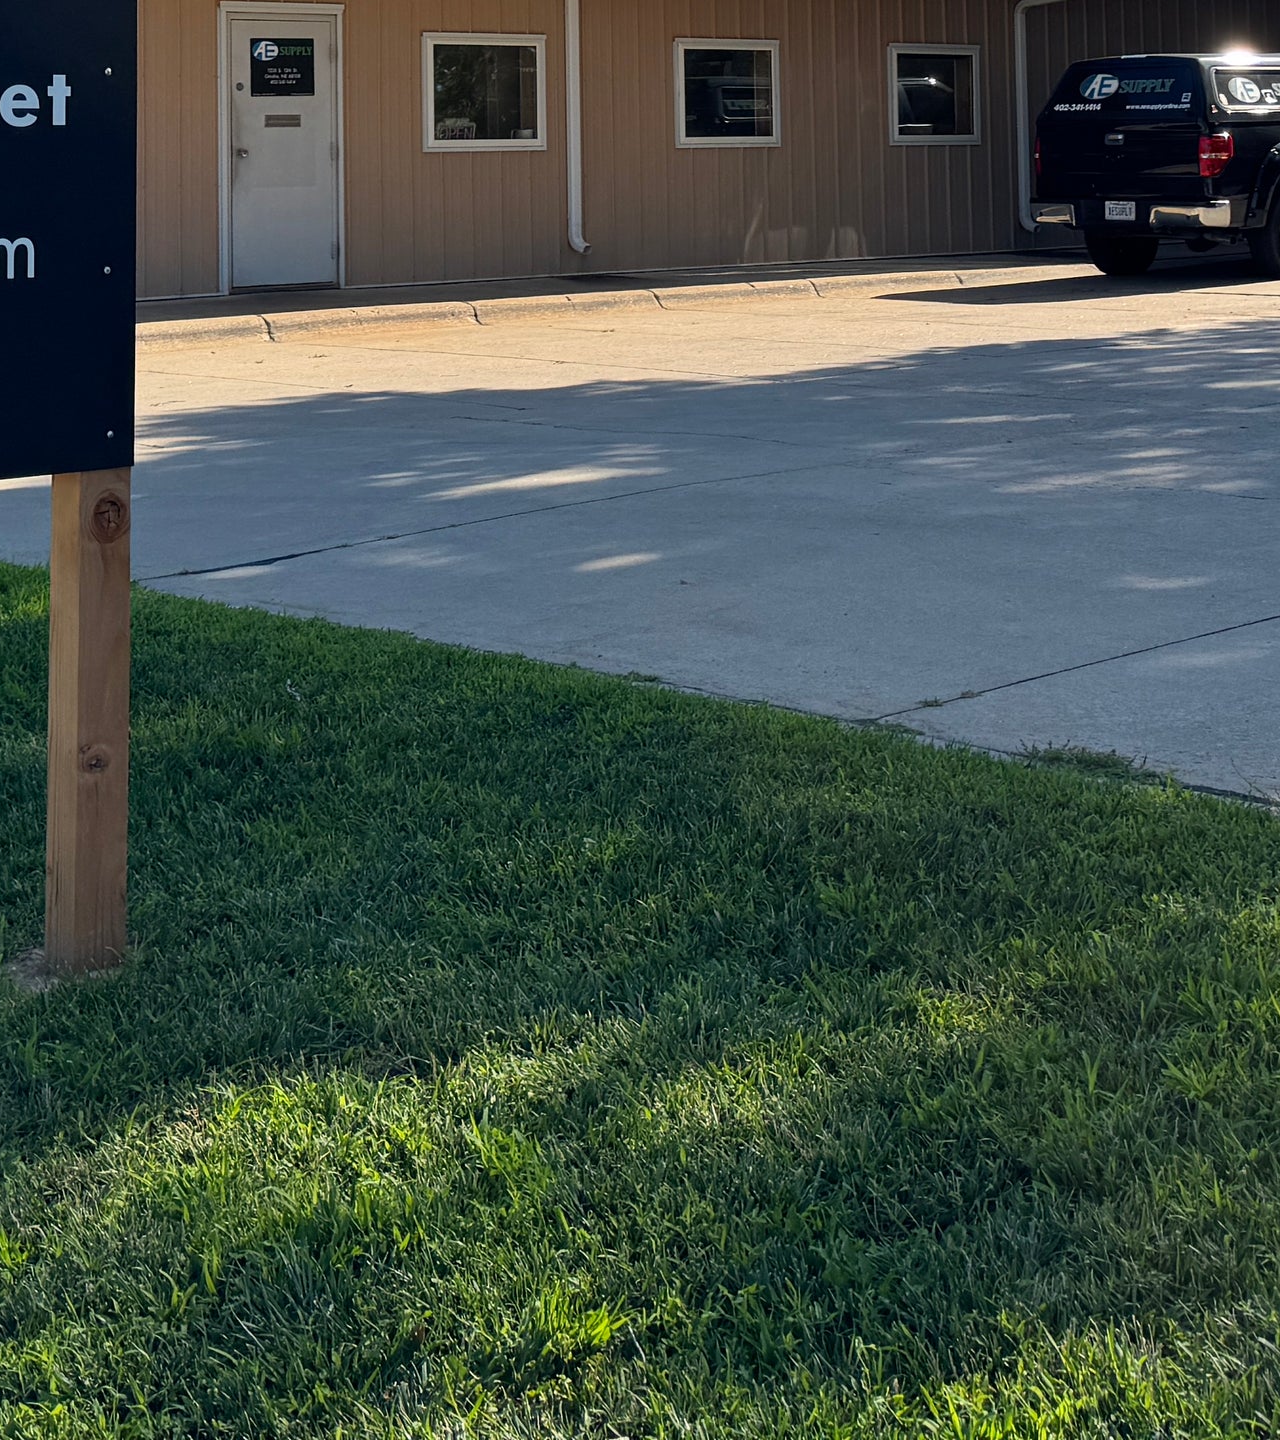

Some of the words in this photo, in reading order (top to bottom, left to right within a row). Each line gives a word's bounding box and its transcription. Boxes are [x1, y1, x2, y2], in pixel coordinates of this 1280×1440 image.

[279, 46, 312, 56] SUPPLY
[1119, 79, 1175, 93] SUPPLY
[1053, 103, 1101, 111] 402-341-1414
[440, 127, 473, 139] OPEN
